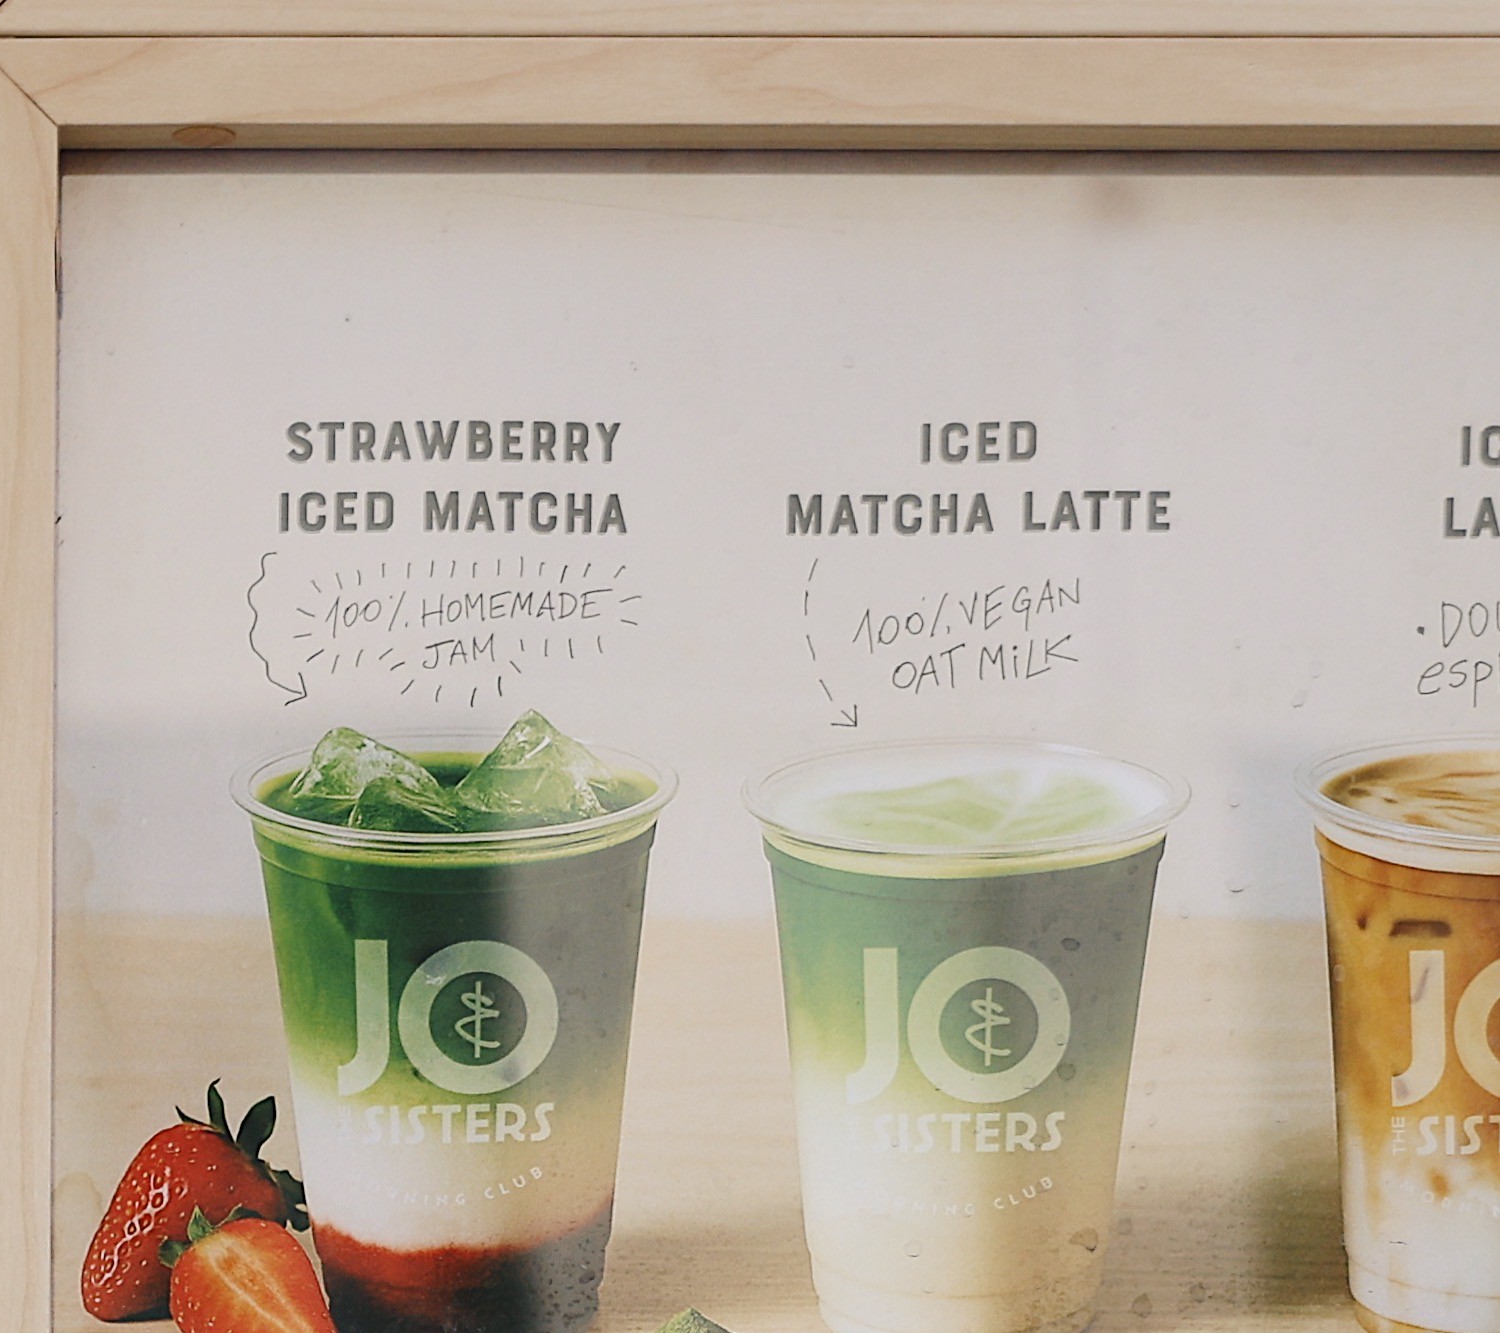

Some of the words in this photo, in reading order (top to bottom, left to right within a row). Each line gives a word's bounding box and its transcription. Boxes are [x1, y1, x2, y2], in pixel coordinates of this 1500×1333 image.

[286, 420, 621, 463] STRAWBERRY
[920, 421, 1037, 464] ICED
[279, 491, 394, 534] ICED
[423, 491, 628, 535] MATCHA
[786, 493, 994, 536] MATCHA
[1022, 490, 1171, 532] LATTE
[421, 588, 613, 628] HOMEMADE
[959, 578, 1080, 630] VEGAN
[422, 633, 495, 670] JAM
[892, 644, 965, 694] OAT
[337, 939, 558, 1096] JO
[845, 946, 1071, 1105] JO
[362, 1101, 556, 1146] SISTERS
[871, 1111, 1066, 1153] SISTERS
[1391, 1116, 1406, 1155] THE
[484, 1166, 543, 1200] CLUB
[993, 1176, 1053, 1210] CLUB
